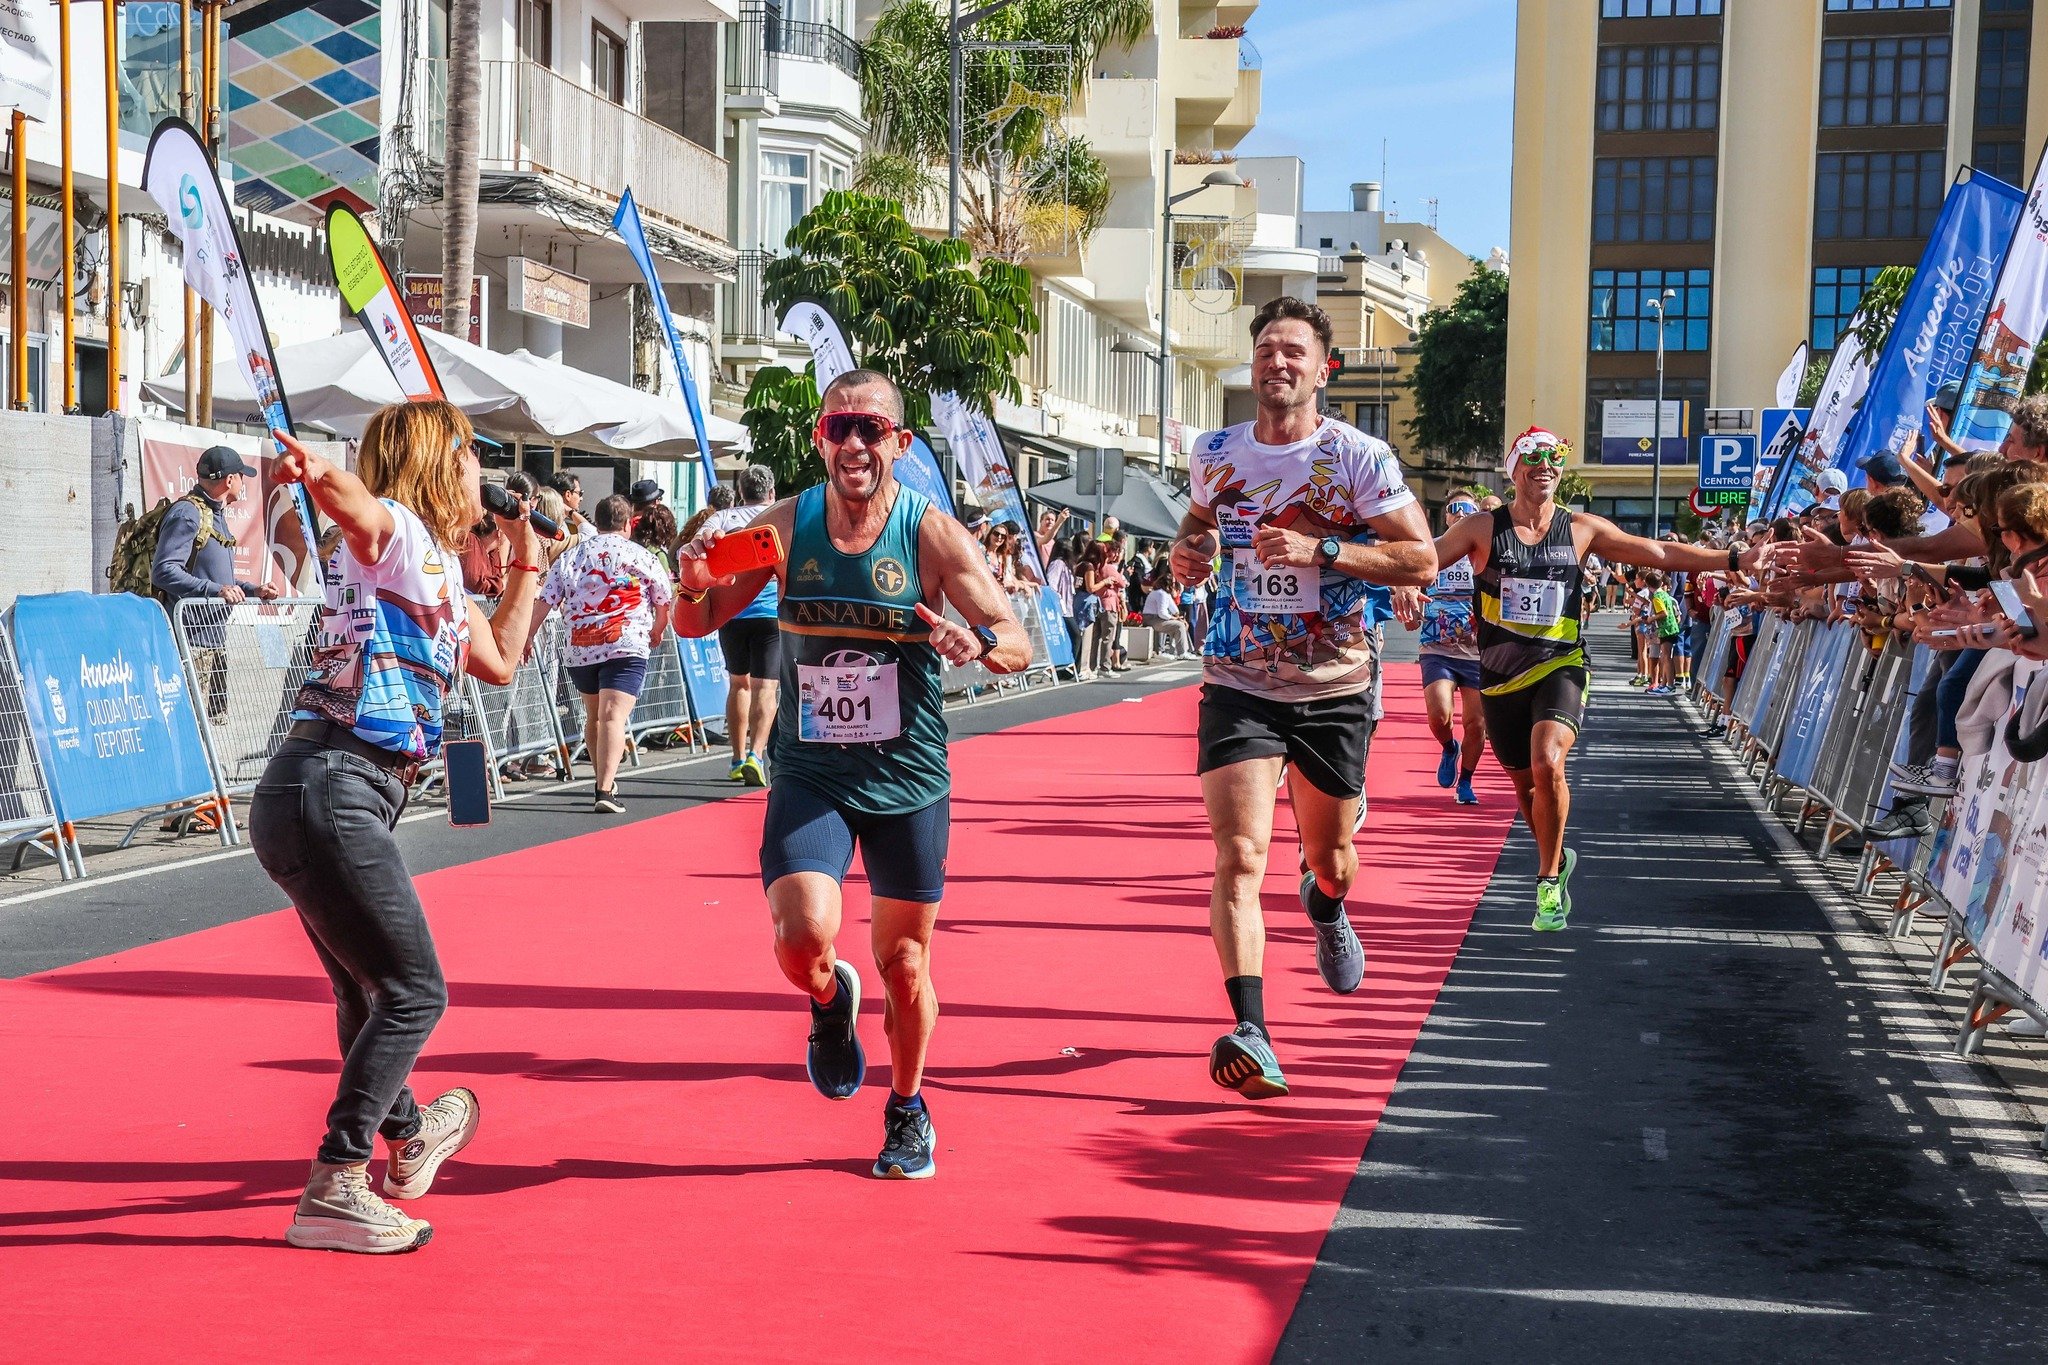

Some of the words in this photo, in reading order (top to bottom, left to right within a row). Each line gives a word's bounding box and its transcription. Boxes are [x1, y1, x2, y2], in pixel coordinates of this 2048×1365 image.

[1903, 257, 1964, 378] Arrecife
[1926, 302, 1969, 387] CIUDAD
[1962, 254, 2000, 295] DEL
[1713, 439, 1742, 475] P
[1705, 492, 1747, 504] LIBRE
[1218, 511, 1232, 519] San
[1252, 574, 1299, 596] 163
[1447, 571, 1469, 581] 693
[796, 601, 905, 630] ANADE
[1520, 596, 1542, 613] 31
[87, 697, 128, 726] CIUDAD
[129, 694, 152, 721] DEL
[818, 695, 871, 722] 401
[94, 727, 145, 758] DEPORTE
